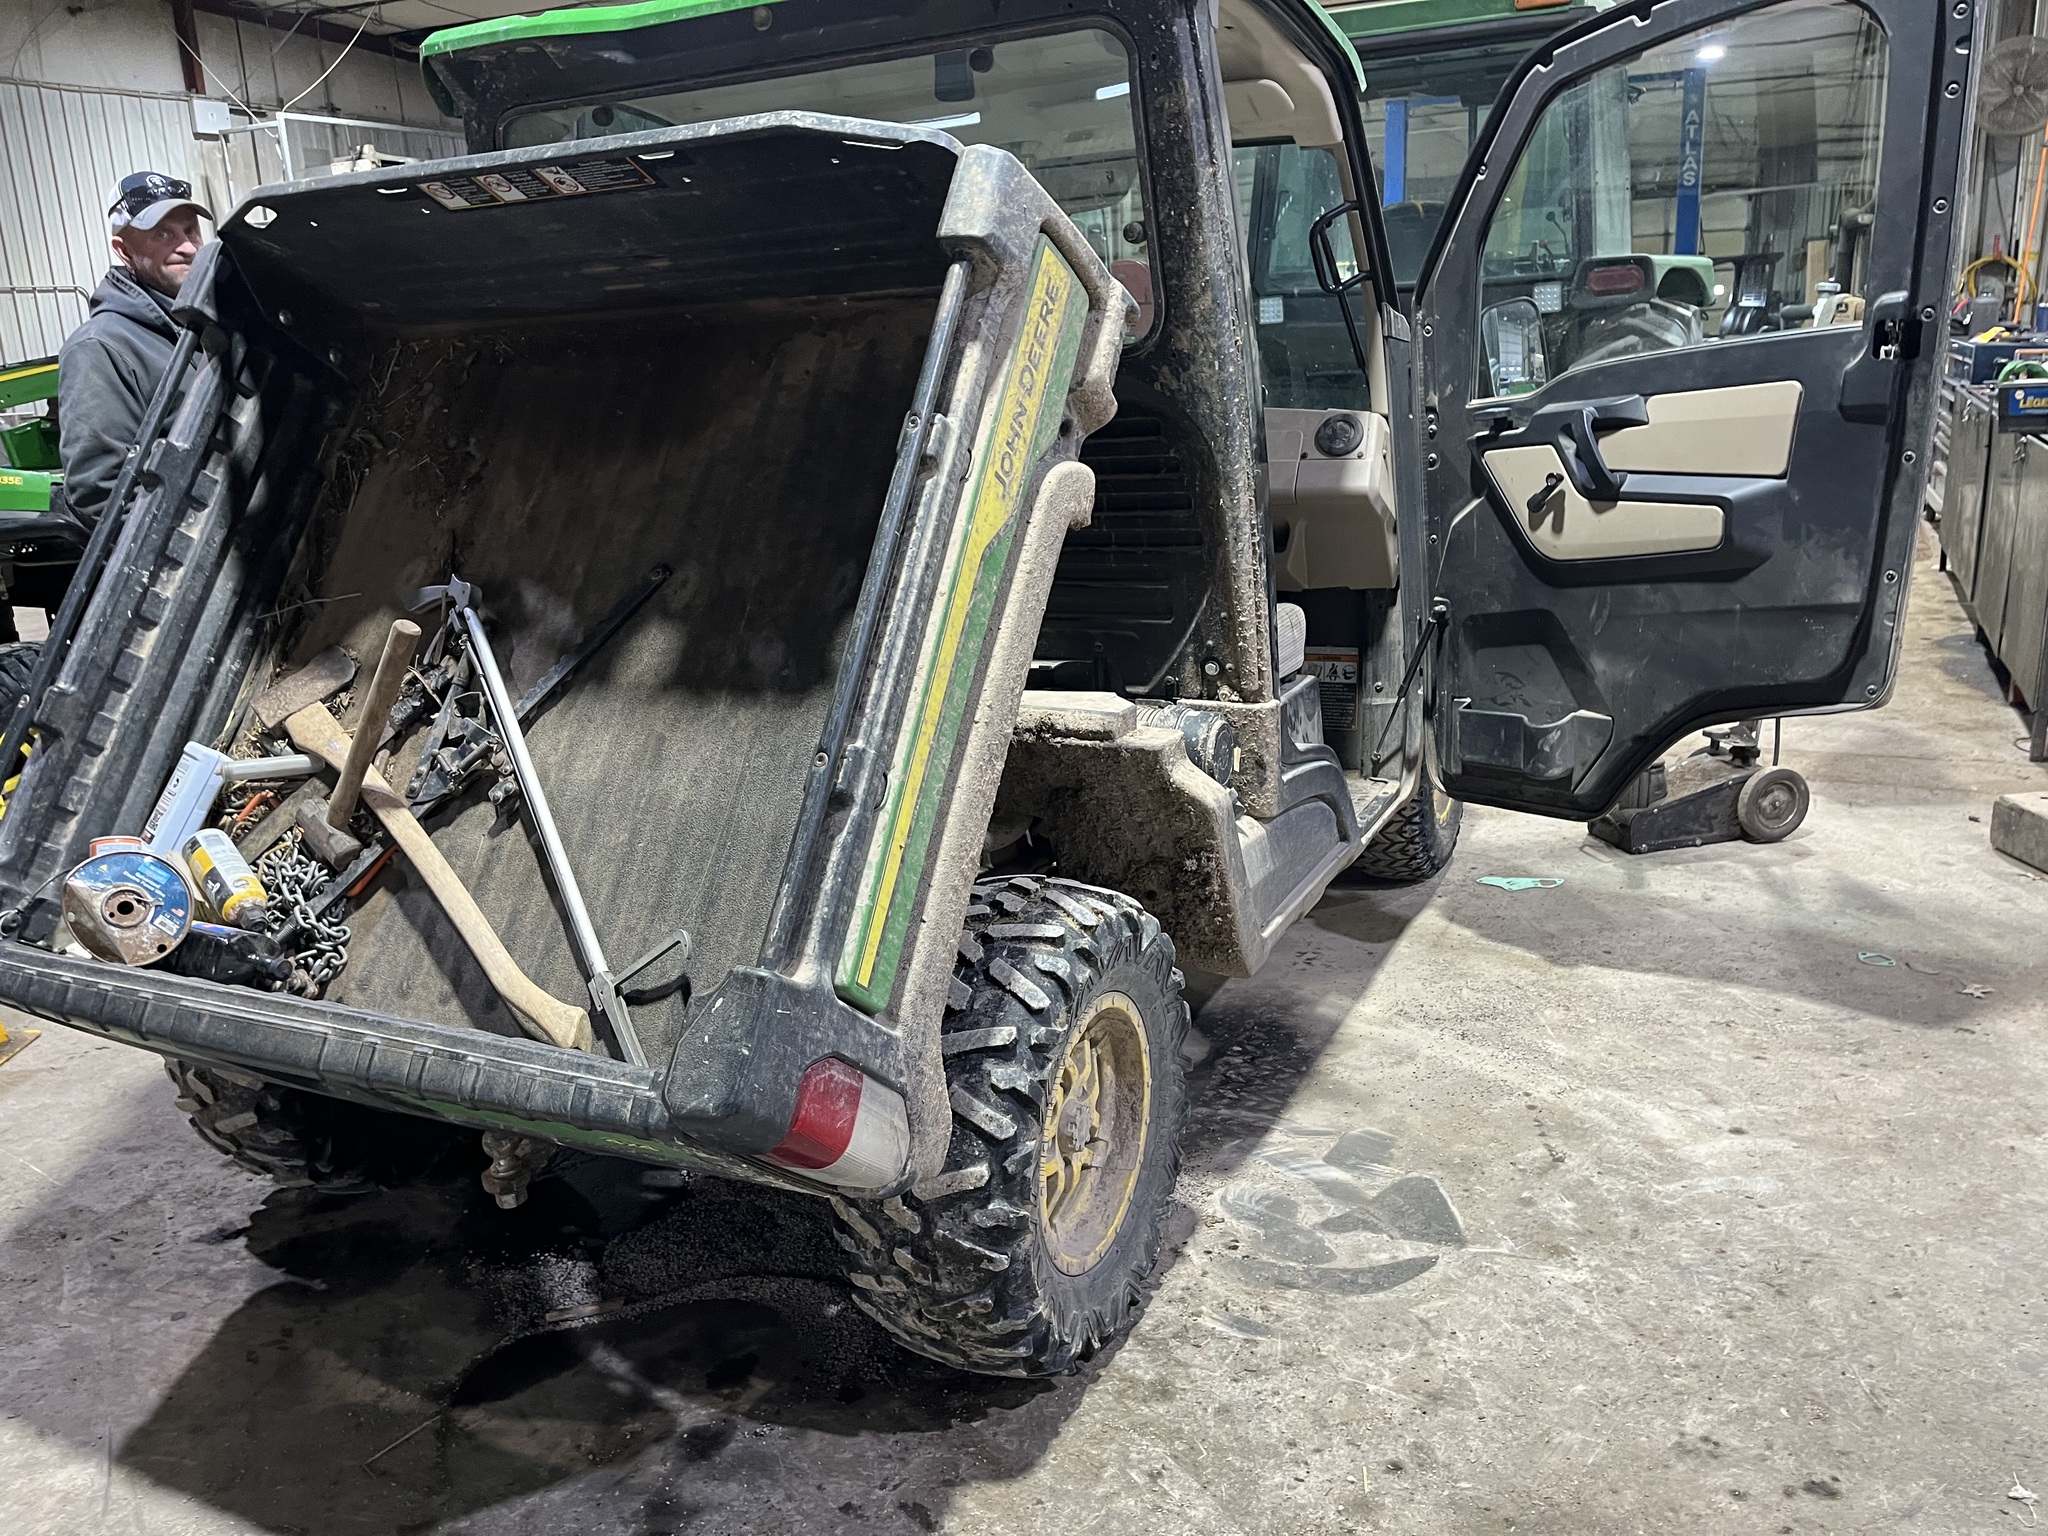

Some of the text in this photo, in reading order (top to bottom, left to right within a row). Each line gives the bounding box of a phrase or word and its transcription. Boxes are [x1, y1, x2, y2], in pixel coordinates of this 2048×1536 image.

[1682, 108, 1700, 187] ATLAS
[994, 276, 1059, 488] JOHN DEERE
